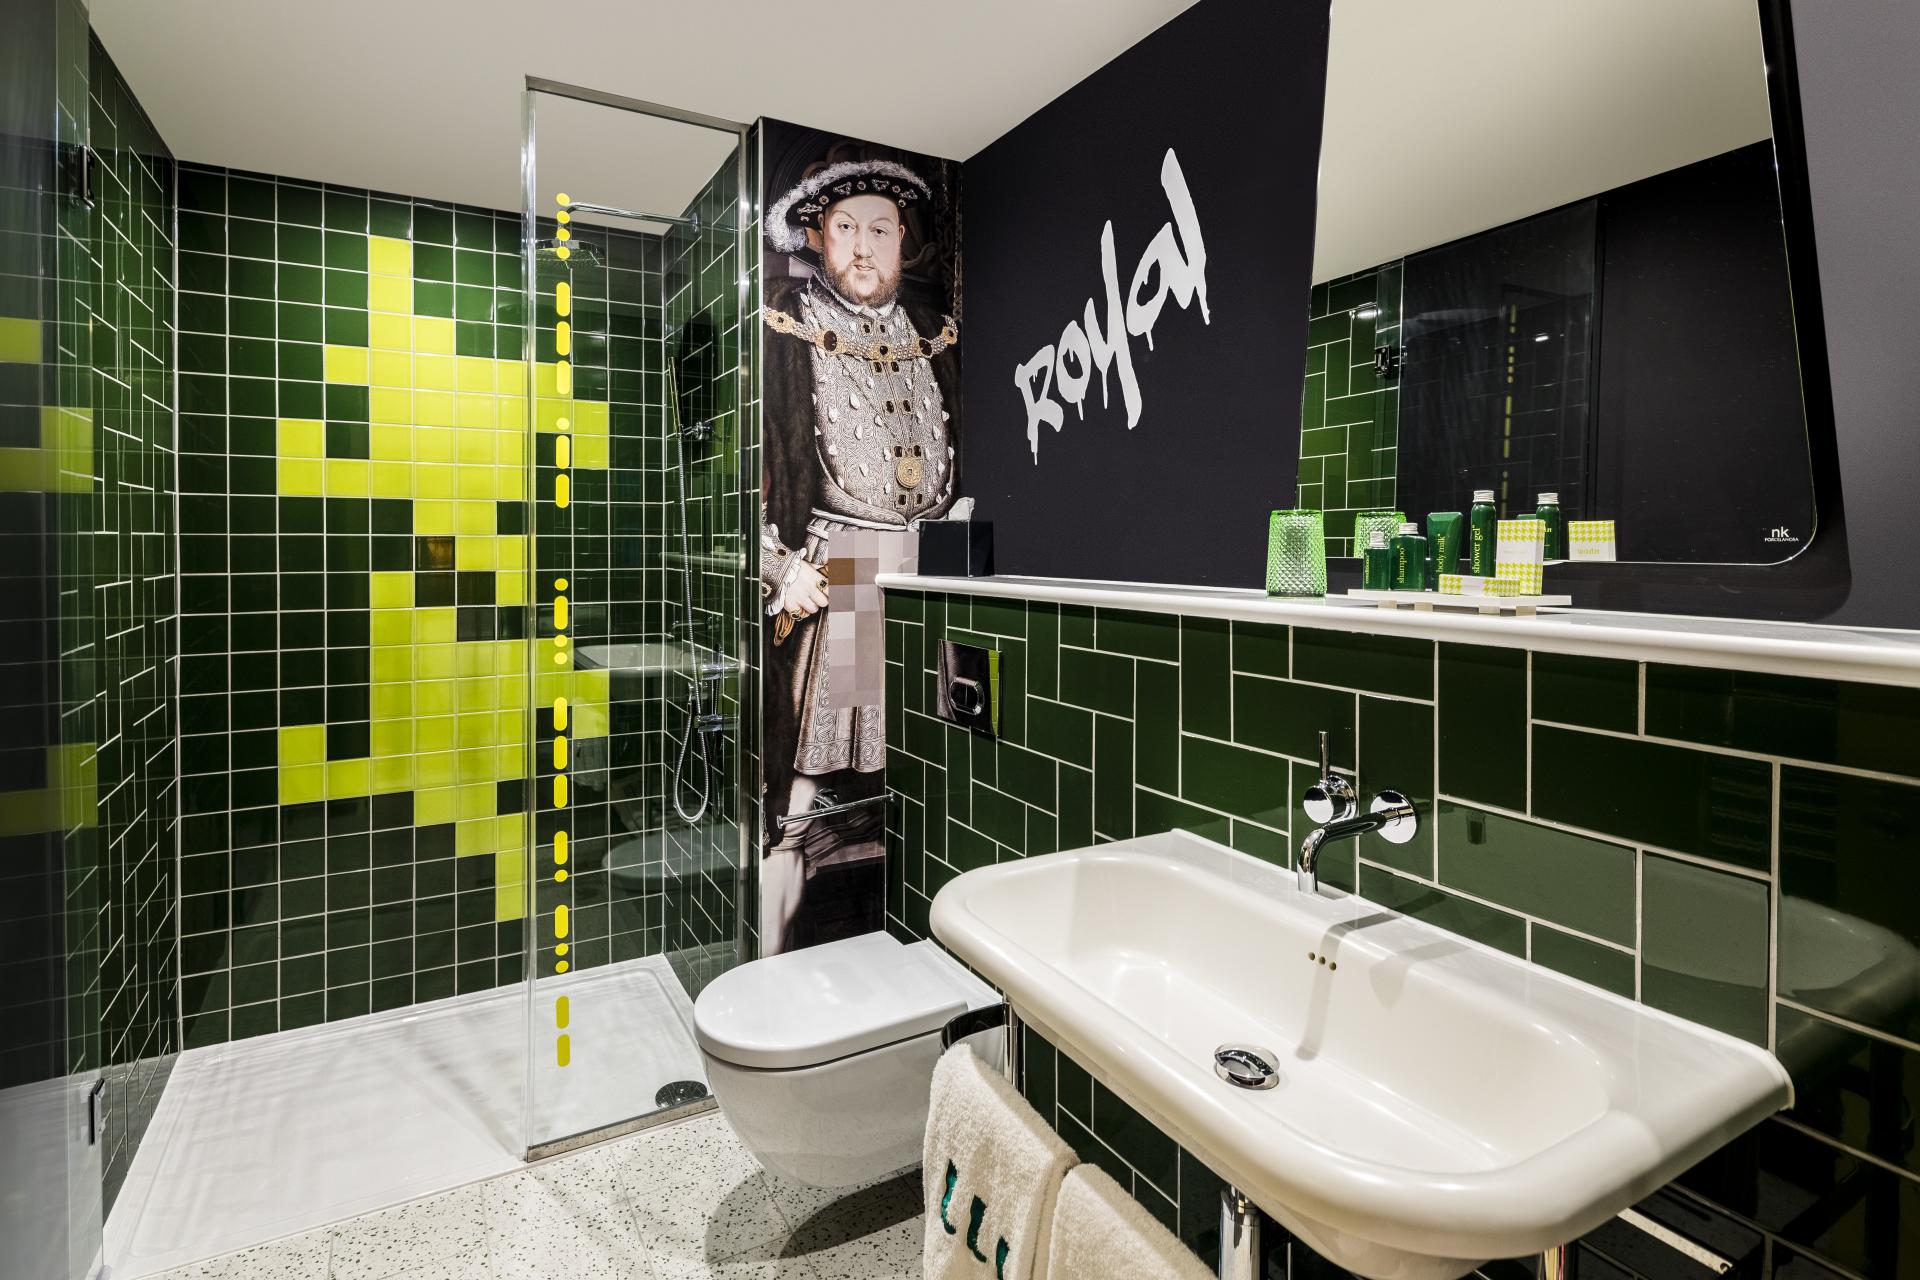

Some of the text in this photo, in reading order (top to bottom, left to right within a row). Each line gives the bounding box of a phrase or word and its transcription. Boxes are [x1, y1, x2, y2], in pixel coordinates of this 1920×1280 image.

[1771, 526, 1789, 537] nk
[1396, 547, 1408, 584] shampoo
[1436, 536, 1447, 573] body milk
[1472, 527, 1484, 574] shower gel
